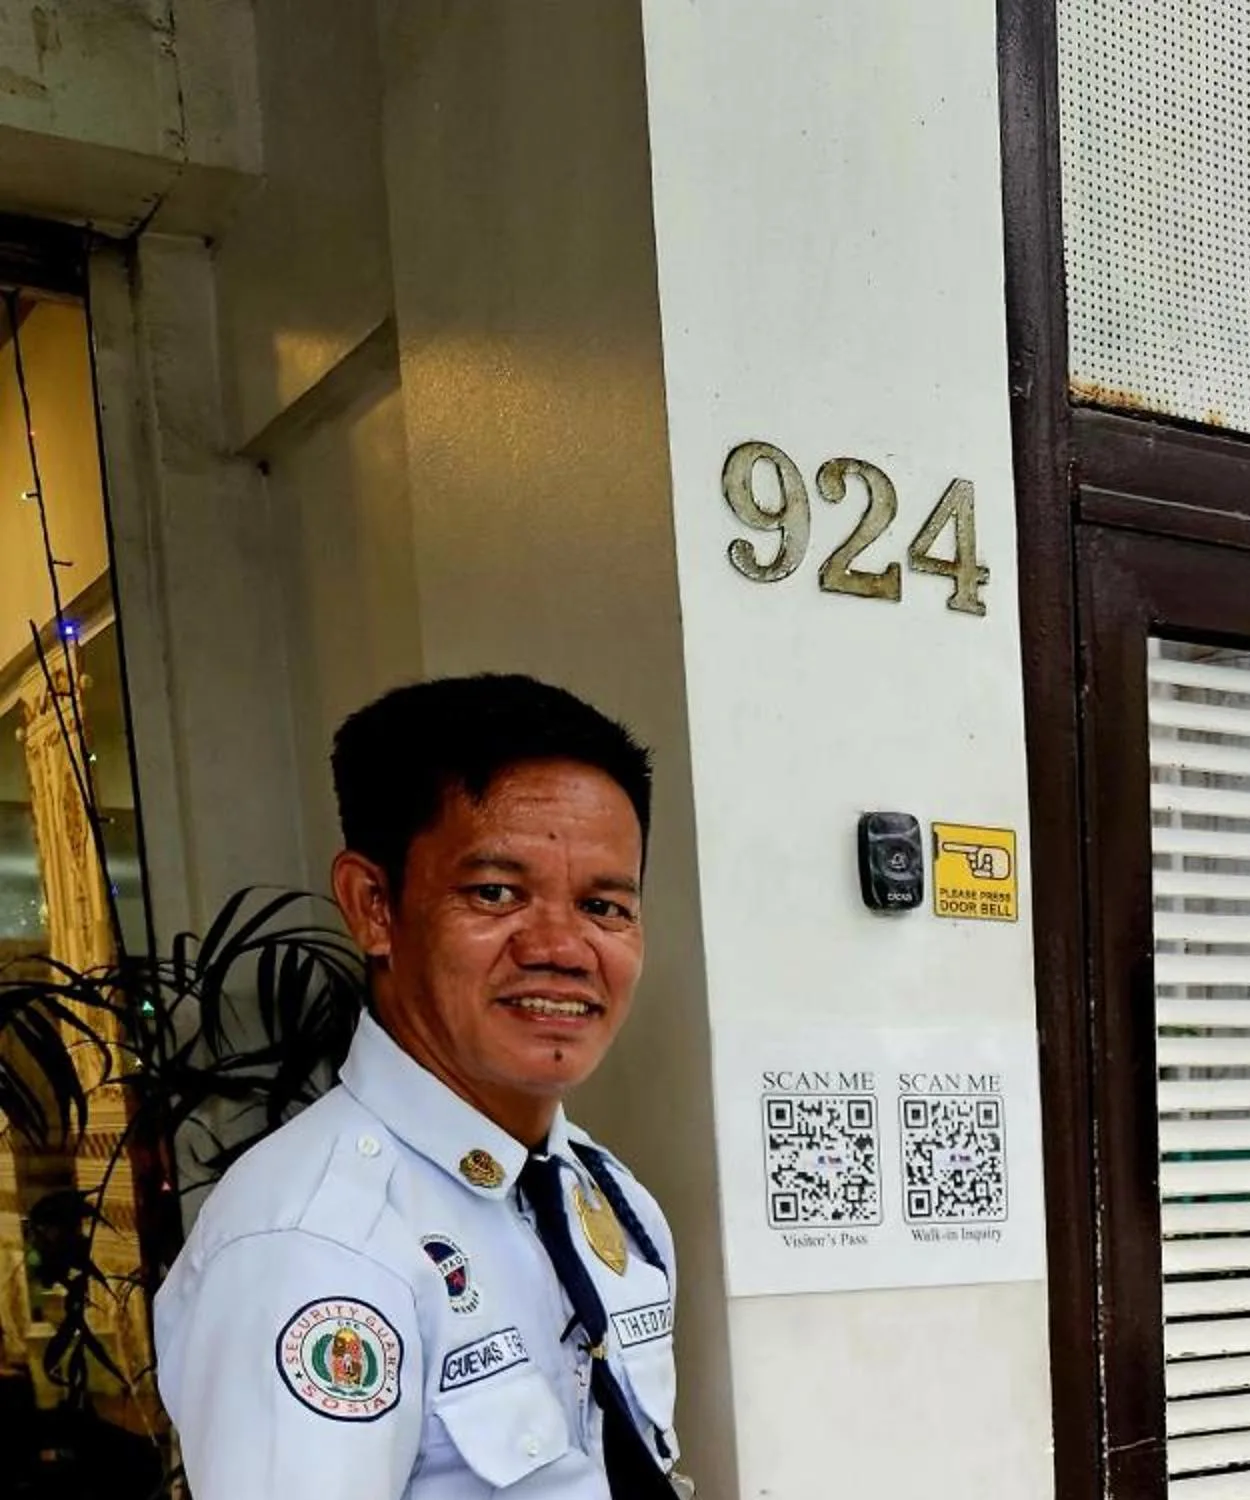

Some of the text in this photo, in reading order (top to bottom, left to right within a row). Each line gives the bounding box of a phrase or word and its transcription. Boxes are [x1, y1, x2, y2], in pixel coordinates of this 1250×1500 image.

[721, 441, 990, 617] 924
[939, 888, 1011, 903] PLEASE PRESS
[939, 900, 1012, 917] DOOR BELL
[762, 1071, 875, 1091] SCAN ME
[899, 1074, 1001, 1092] SCAN ME
[782, 1232, 868, 1248] Visitor's Pass
[910, 1227, 1002, 1243] Walk-in Inquiry
[286, 1304, 359, 1365] SECURITY
[445, 1341, 505, 1381] CUEVAS
[302, 1384, 386, 1413] SOSIA
